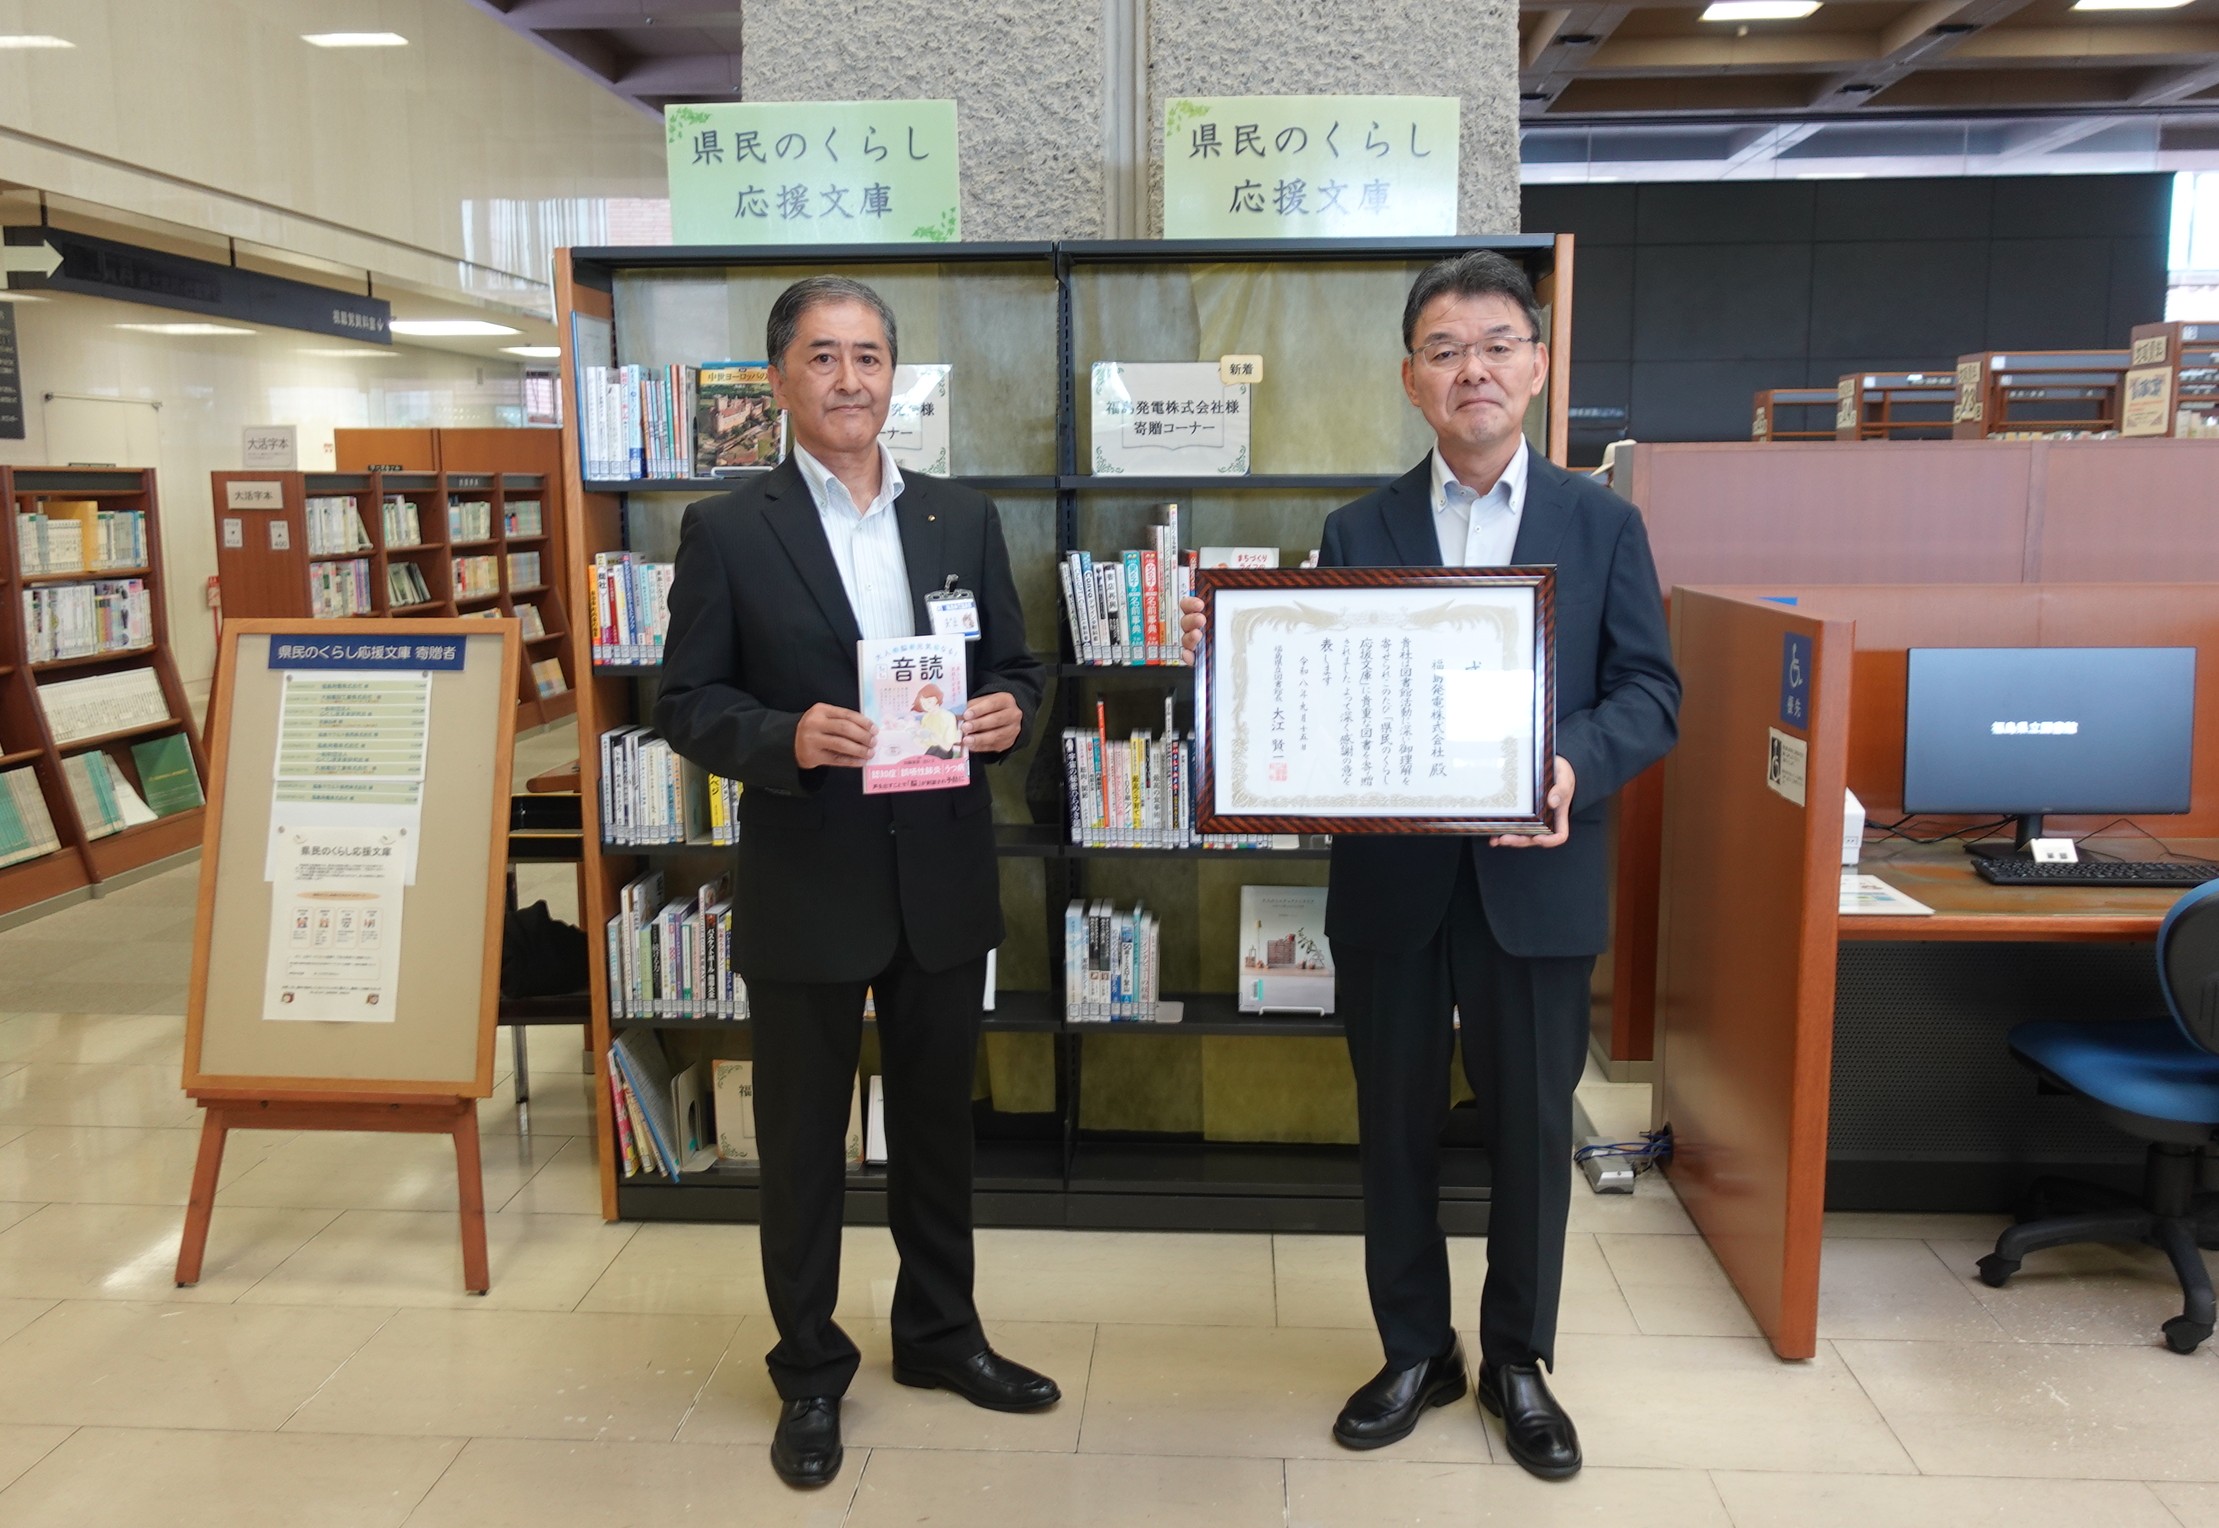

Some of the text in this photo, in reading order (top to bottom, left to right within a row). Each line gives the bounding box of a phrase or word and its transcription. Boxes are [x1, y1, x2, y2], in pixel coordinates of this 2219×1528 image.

[692, 126, 929, 165] 県民のくらし
[1189, 121, 1431, 159] 県民のくらし
[734, 182, 893, 219] 応援文庫
[1229, 177, 1391, 216] 応援文庫
[1230, 363, 1253, 375] 新着
[1134, 421, 1215, 435] 寄贈コーナー
[247, 438, 289, 450] 大活字本
[235, 490, 273, 501] 大活字本
[278, 646, 456, 660] 県民のくらし応援文庫 寄贈者
[1321, 637, 1333, 686] 表します
[891, 654, 944, 681] 音読
[301, 845, 392, 857] 県民のくらし応援文庫
